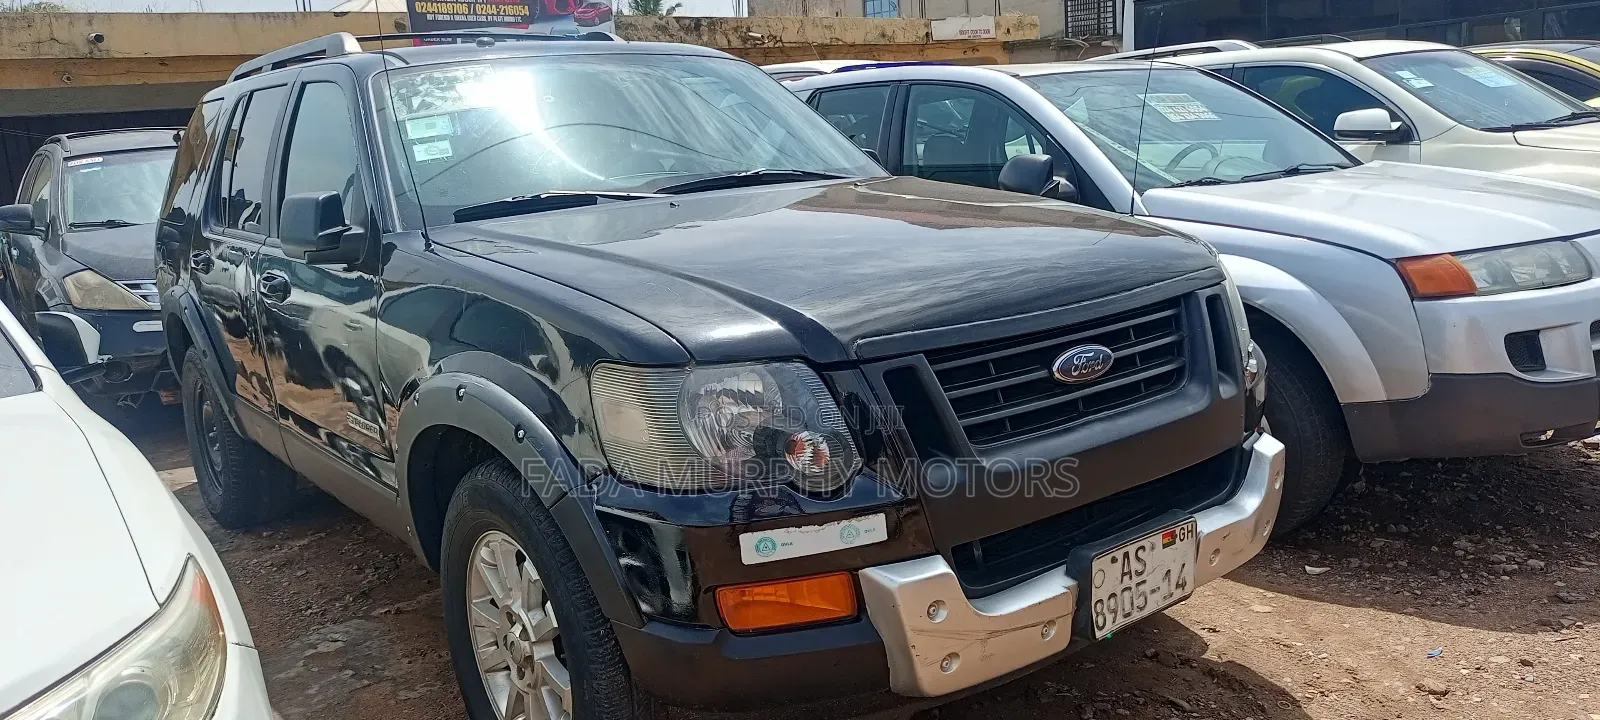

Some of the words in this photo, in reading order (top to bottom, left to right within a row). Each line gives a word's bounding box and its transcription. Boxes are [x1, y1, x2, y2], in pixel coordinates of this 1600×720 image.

[415, 1, 469, 14] 0244189706
[475, 3, 530, 16] 0244-216054
[1071, 352, 1104, 376] Ford
[1178, 523, 1194, 542] GH
[1120, 545, 1147, 584] AS
[1093, 562, 1187, 631] 8905-14
